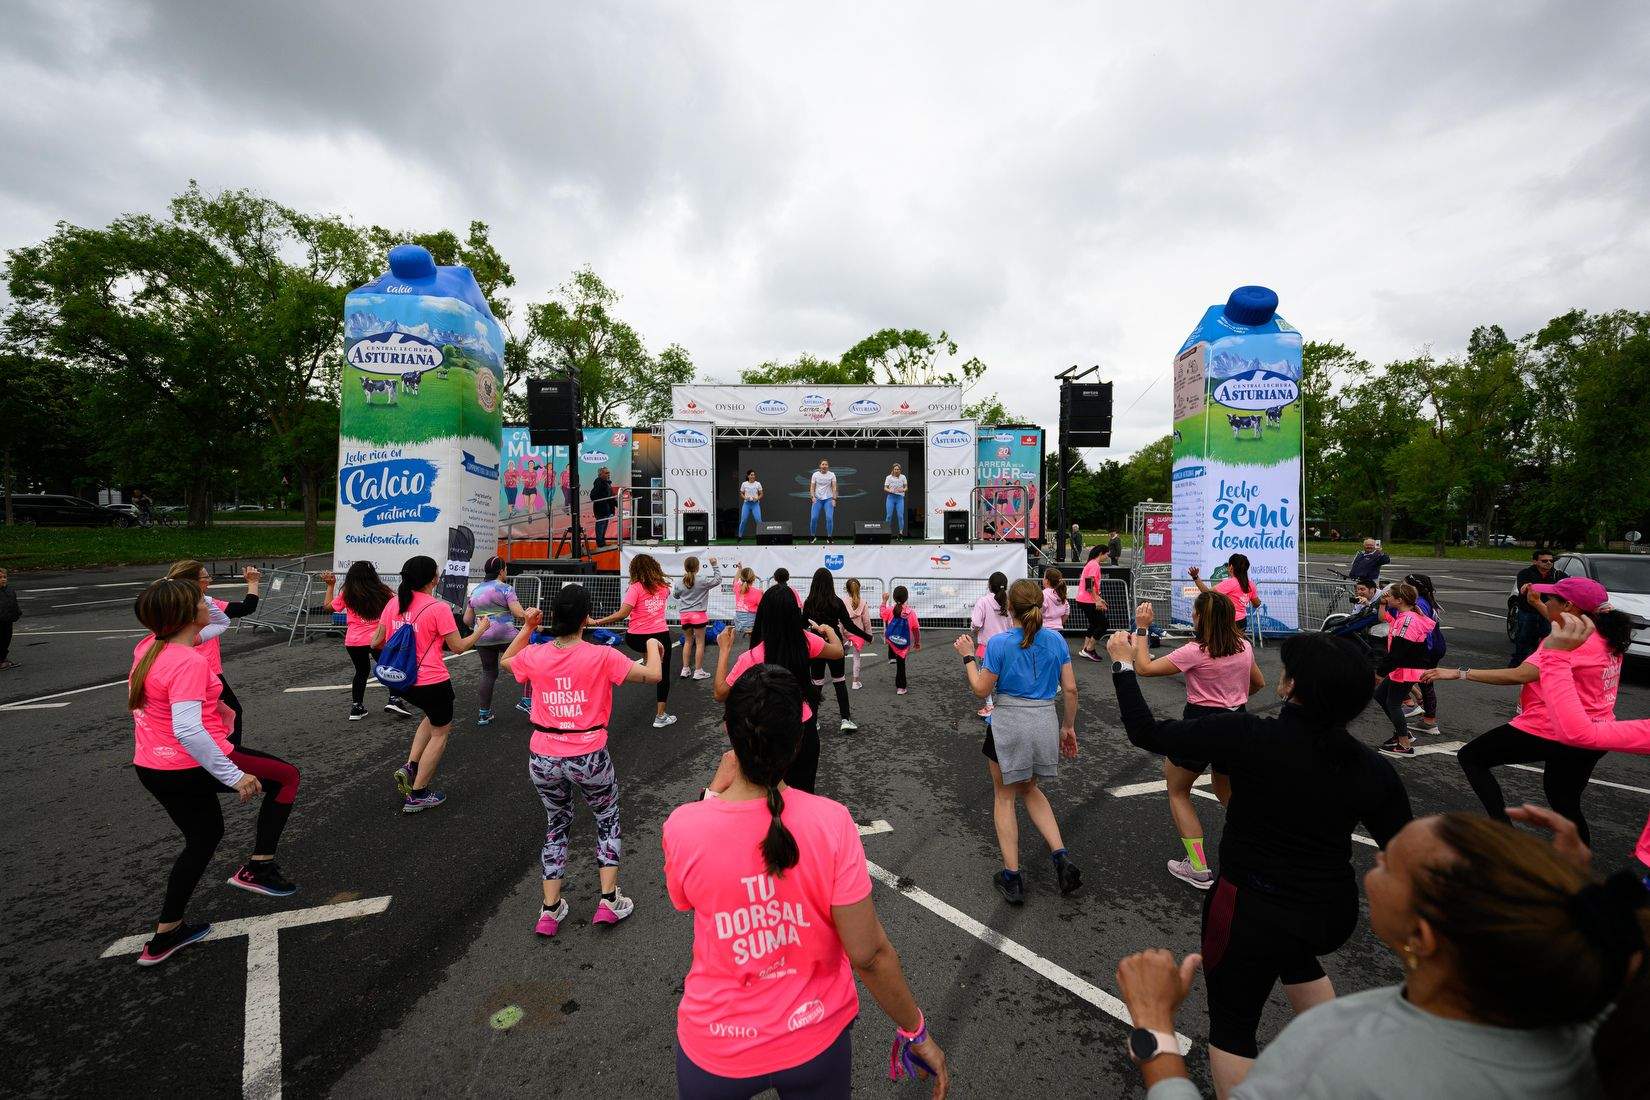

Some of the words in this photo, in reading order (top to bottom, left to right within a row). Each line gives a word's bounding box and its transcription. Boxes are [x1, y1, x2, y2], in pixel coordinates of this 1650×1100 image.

[386, 285, 414, 294] Calcio
[352, 347, 436, 366] ASTURIANA
[1219, 386, 1294, 401] ASTURIANA
[508, 440, 580, 458] MUJE
[345, 452, 367, 466] Leche
[369, 450, 387, 460] rica
[390, 449, 402, 458] en
[671, 468, 708, 477] OYSHO
[933, 468, 969, 477] OYSHO
[345, 467, 425, 505] Calcio
[1216, 480, 1260, 504] Leche
[376, 506, 422, 521] natural
[1212, 498, 1294, 530] semi
[345, 533, 420, 546] semidesnatada
[1211, 528, 1296, 550] desnatada
[555, 677, 571, 689] TU
[542, 690, 588, 704] DORSAL
[548, 704, 582, 718] SUMA
[740, 874, 775, 902] TU
[714, 900, 811, 940] DORSAL
[732, 924, 802, 965] SUMA
[709, 1022, 758, 1038] OYSHO
